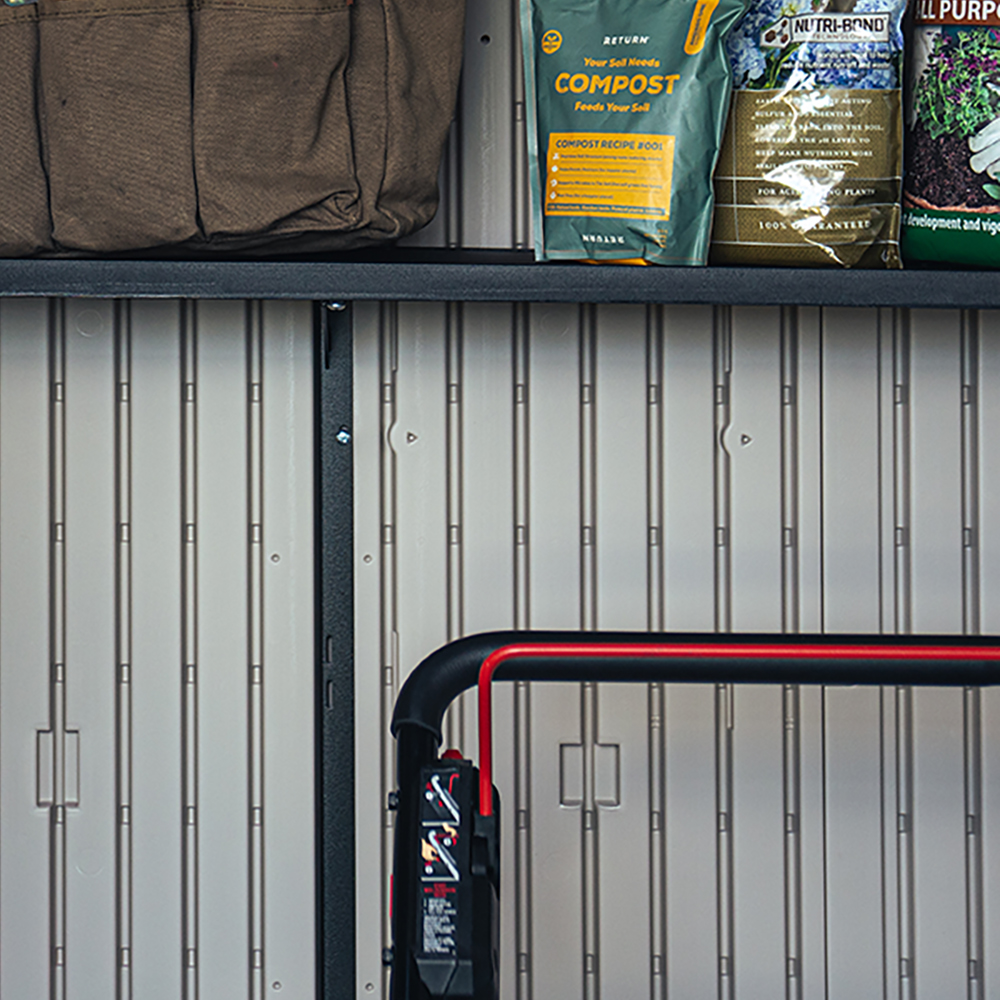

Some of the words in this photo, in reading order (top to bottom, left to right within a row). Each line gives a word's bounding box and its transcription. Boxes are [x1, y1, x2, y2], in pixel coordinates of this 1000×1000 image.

[795, 17, 885, 32] NUTRI-BOND
[603, 35, 650, 45] RETURN
[584, 57, 607, 67] Your
[609, 58, 627, 67] Soil
[628, 57, 660, 67] Needs
[555, 72, 681, 95] COMPOST
[574, 101, 604, 112] Feeds
[606, 102, 630, 112] Your
[631, 102, 650, 112] Soil
[556, 140, 600, 149] COMPOST
[601, 140, 635, 150] RECIPE
[759, 221, 787, 229] 100%
[792, 220, 871, 229] GARANTEED
[963, 216, 981, 230] and
